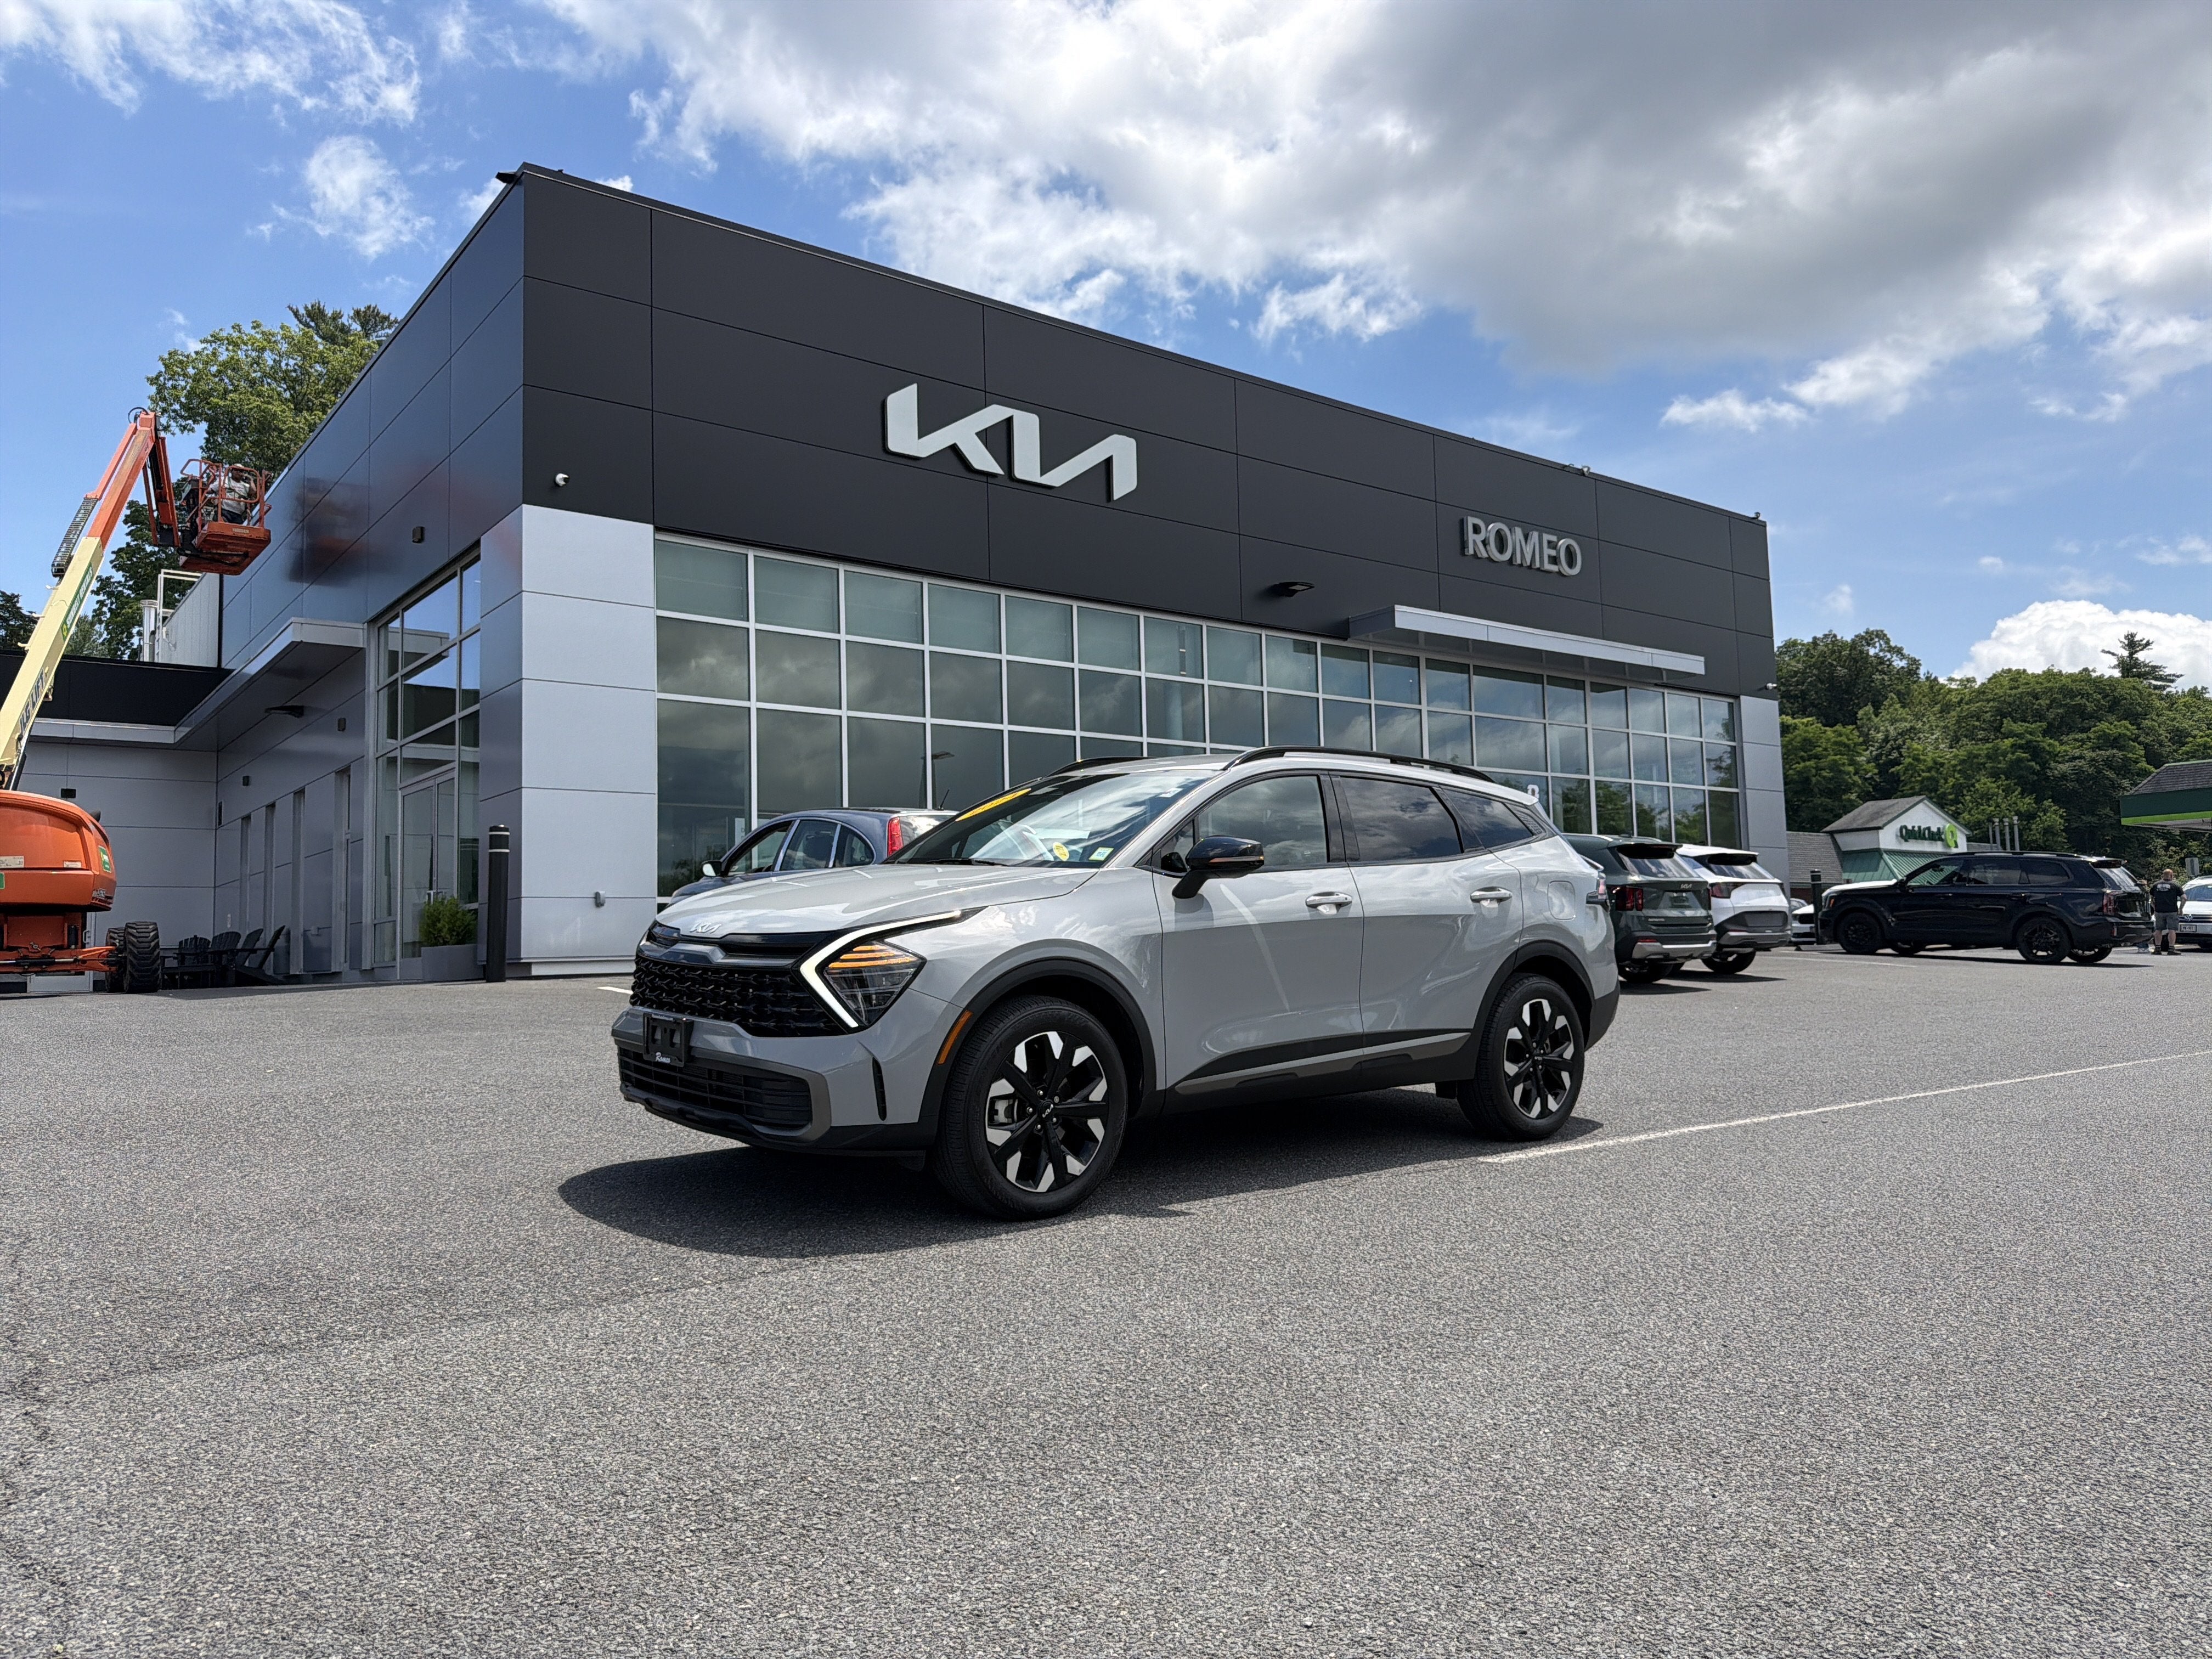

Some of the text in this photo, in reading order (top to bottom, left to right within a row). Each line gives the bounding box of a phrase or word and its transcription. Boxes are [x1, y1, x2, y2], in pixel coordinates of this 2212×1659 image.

[884, 382, 1137, 501] KIA
[1463, 516, 1582, 576] ROMEO
[30, 667, 45, 713] LIFT
[690, 922, 721, 934] KIA
